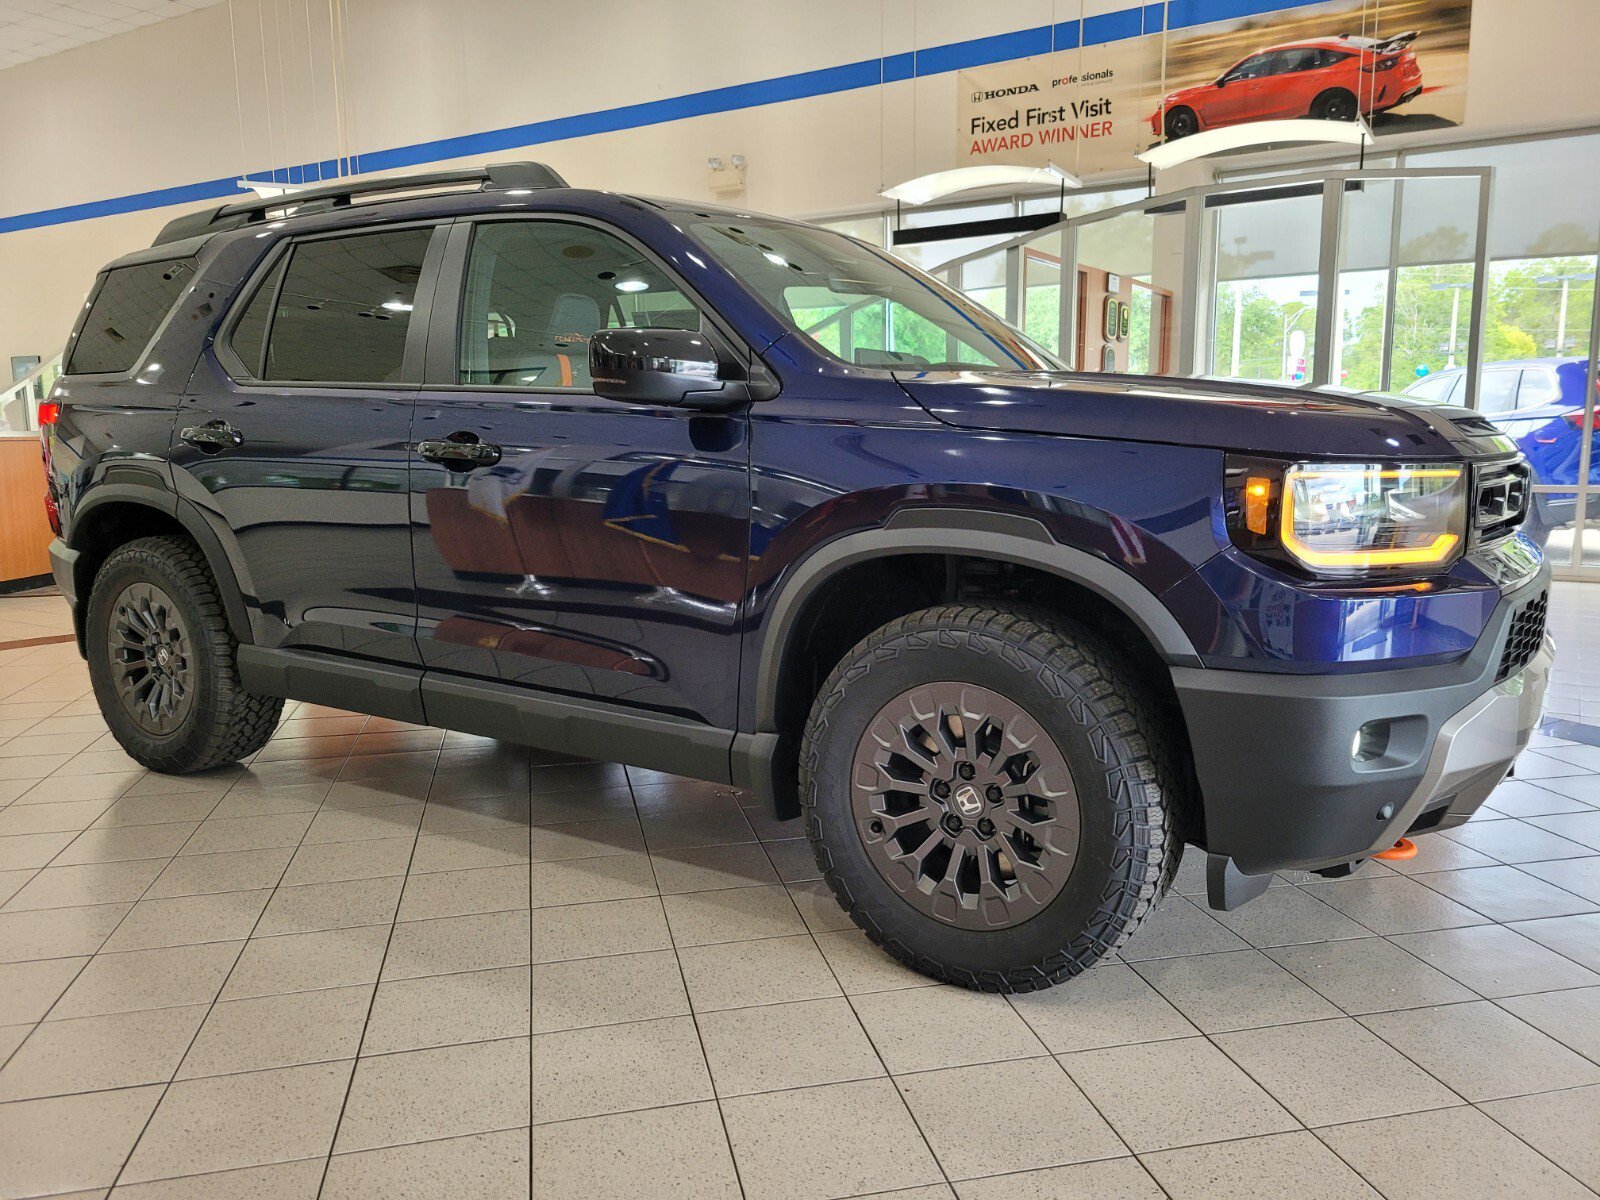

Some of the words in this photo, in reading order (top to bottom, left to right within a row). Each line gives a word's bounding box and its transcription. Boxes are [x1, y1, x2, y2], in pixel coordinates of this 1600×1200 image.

[984, 83, 1040, 100] HONDA
[1051, 69, 1114, 88] profesionals
[971, 109, 1019, 135] Fixed
[1026, 106, 1066, 126] First
[1070, 97, 1113, 120] Visit
[969, 132, 1034, 155] AWARD
[1038, 120, 1113, 146] WINNER
